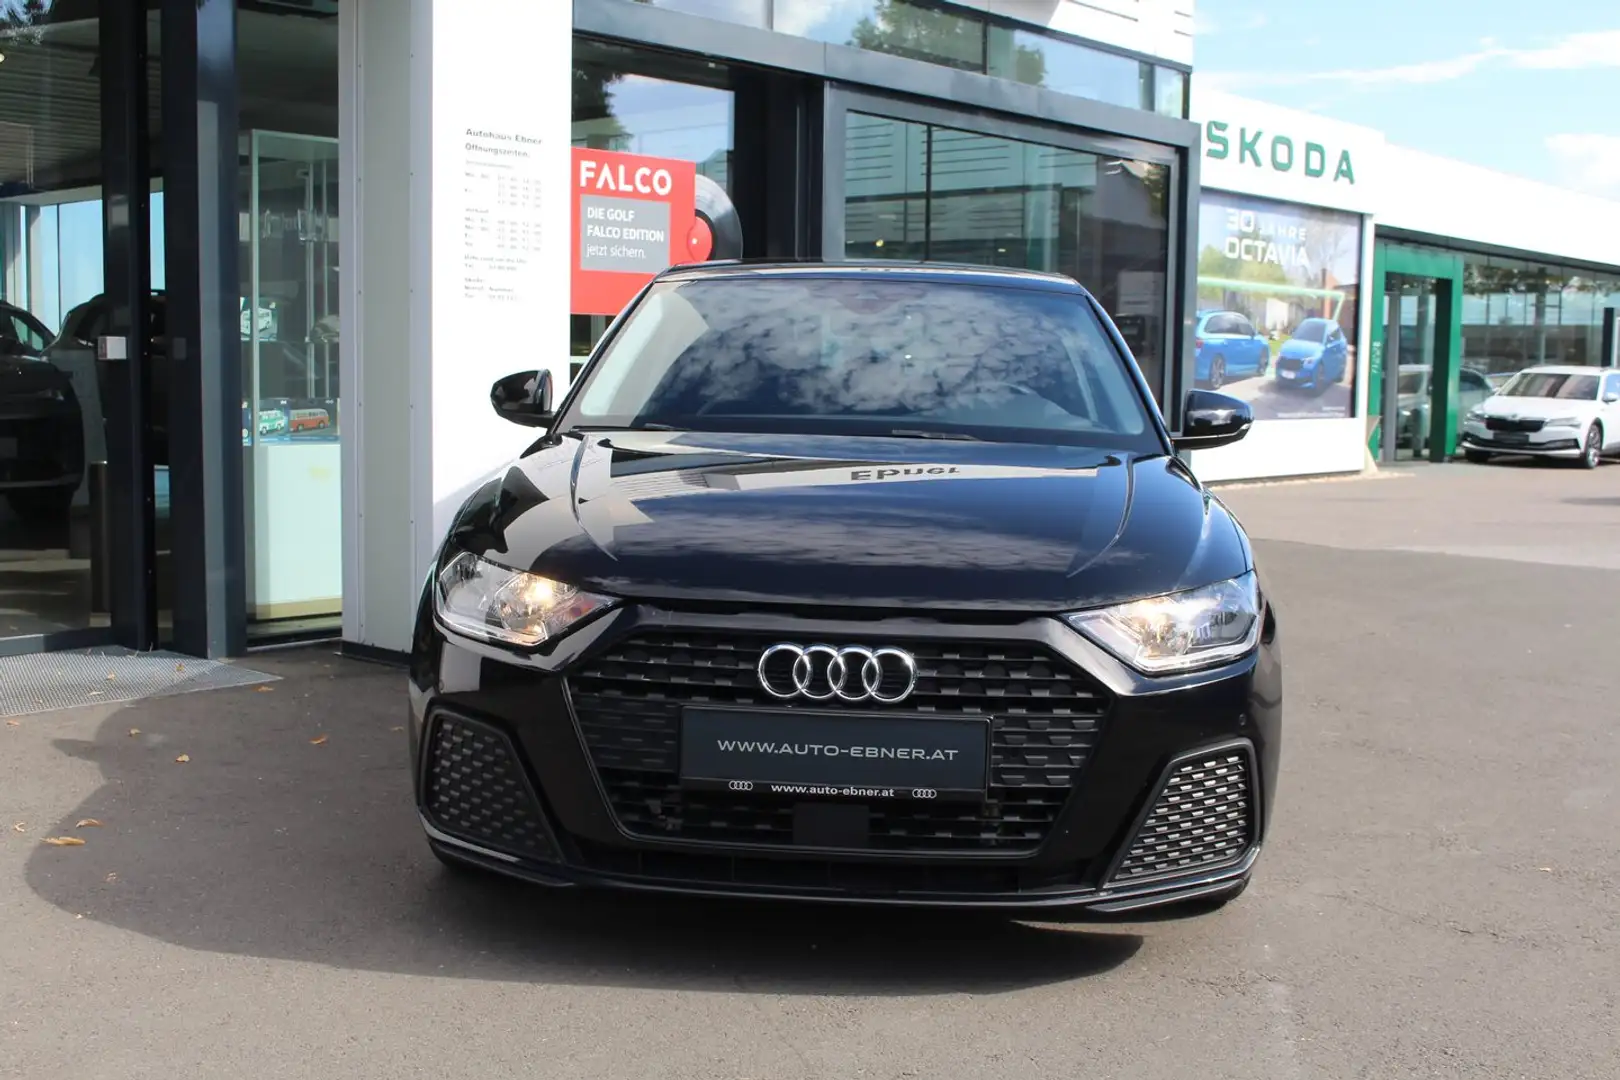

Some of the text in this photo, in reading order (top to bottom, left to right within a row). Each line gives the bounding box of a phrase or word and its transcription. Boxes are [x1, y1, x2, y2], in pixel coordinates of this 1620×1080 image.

[465, 128, 543, 145] Autohaus Ebner
[580, 159, 673, 195] FALCO
[587, 207, 635, 222] DIE GOLF
[1226, 208, 1255, 232] 30
[587, 224, 665, 242] FALCO EDITION
[586, 243, 647, 260] jetzt sichern.
[1225, 237, 1311, 266] OCTAVIA
[717, 739, 959, 761] WWW.AUTO-EBNER.AT
[771, 784, 895, 797] www.auto-ebner.at
